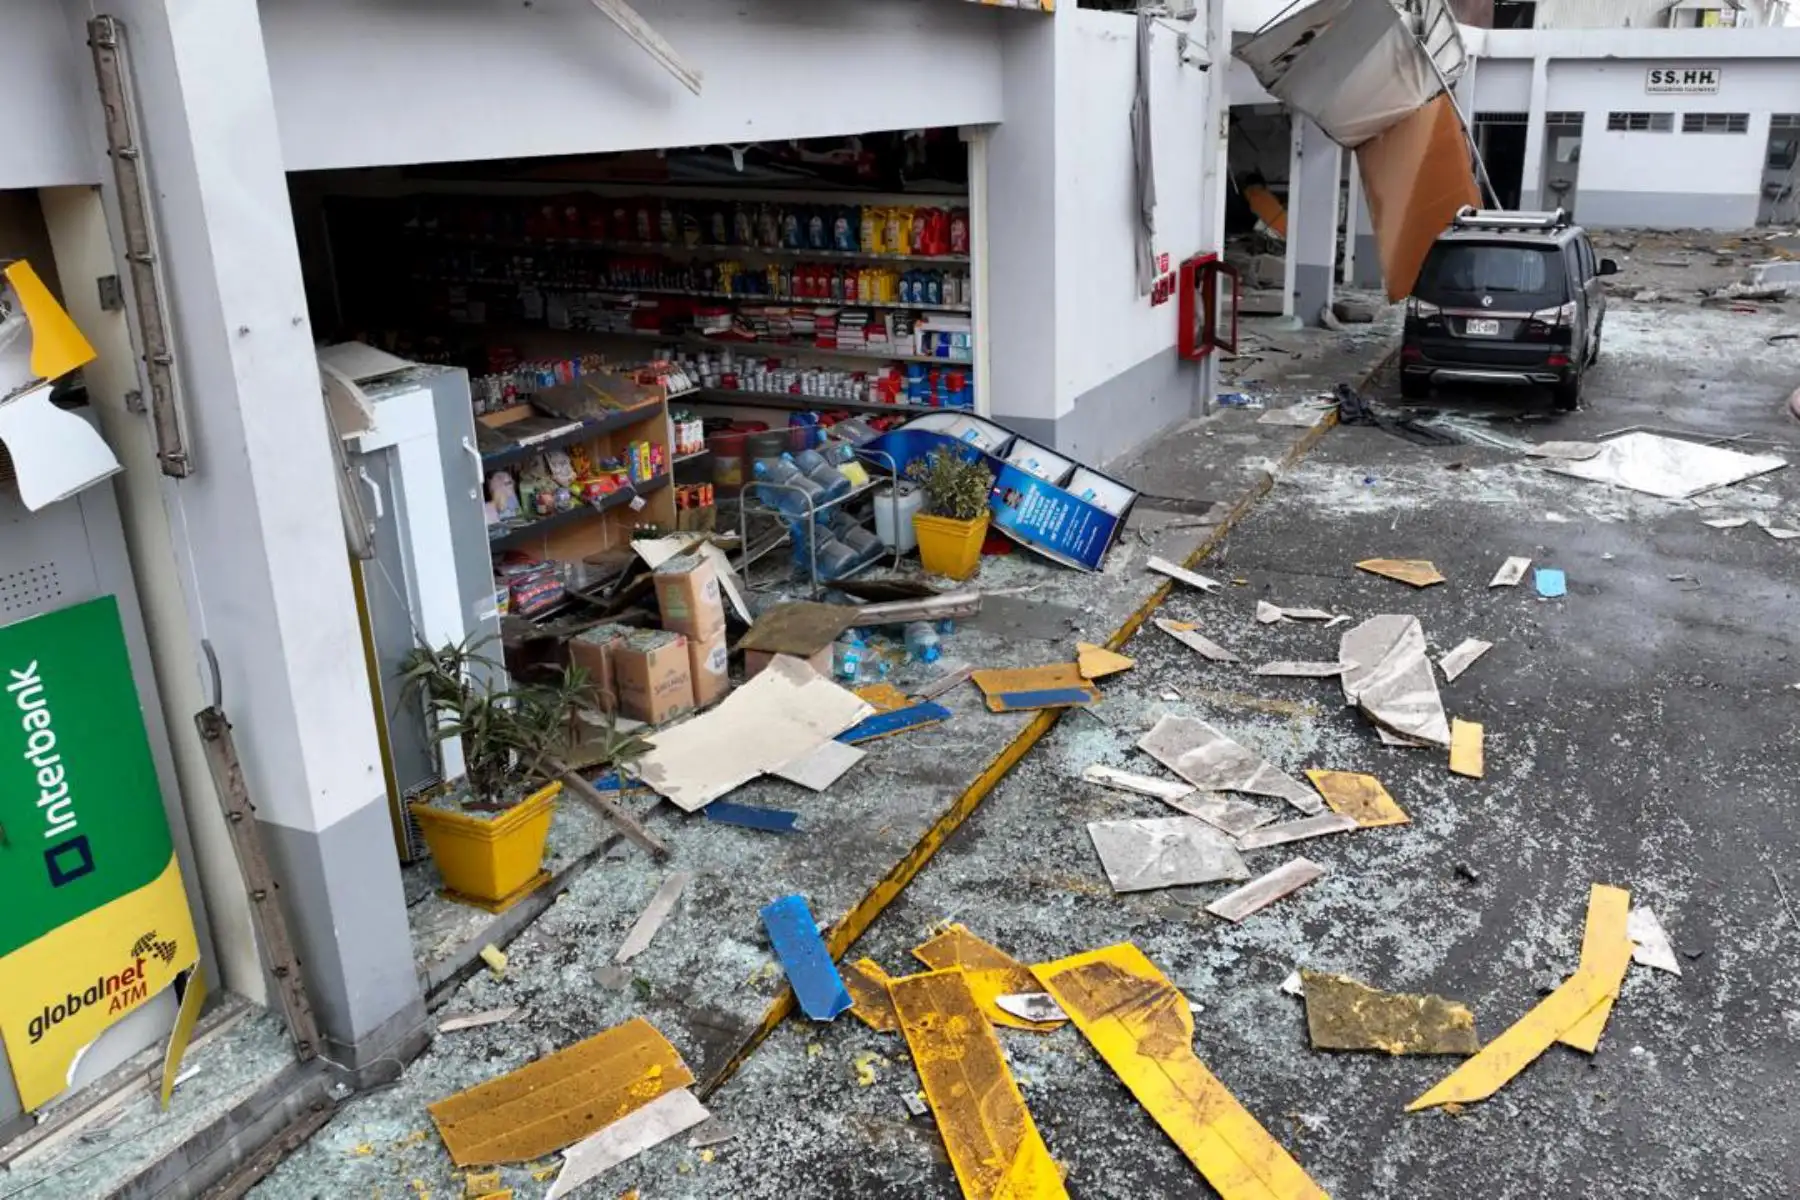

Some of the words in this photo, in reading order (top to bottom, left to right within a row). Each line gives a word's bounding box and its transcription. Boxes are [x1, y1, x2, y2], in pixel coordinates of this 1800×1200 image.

[6, 659, 78, 839] Interbank
[28, 957, 147, 1045] globalnet
[108, 981, 148, 1016] ATM
